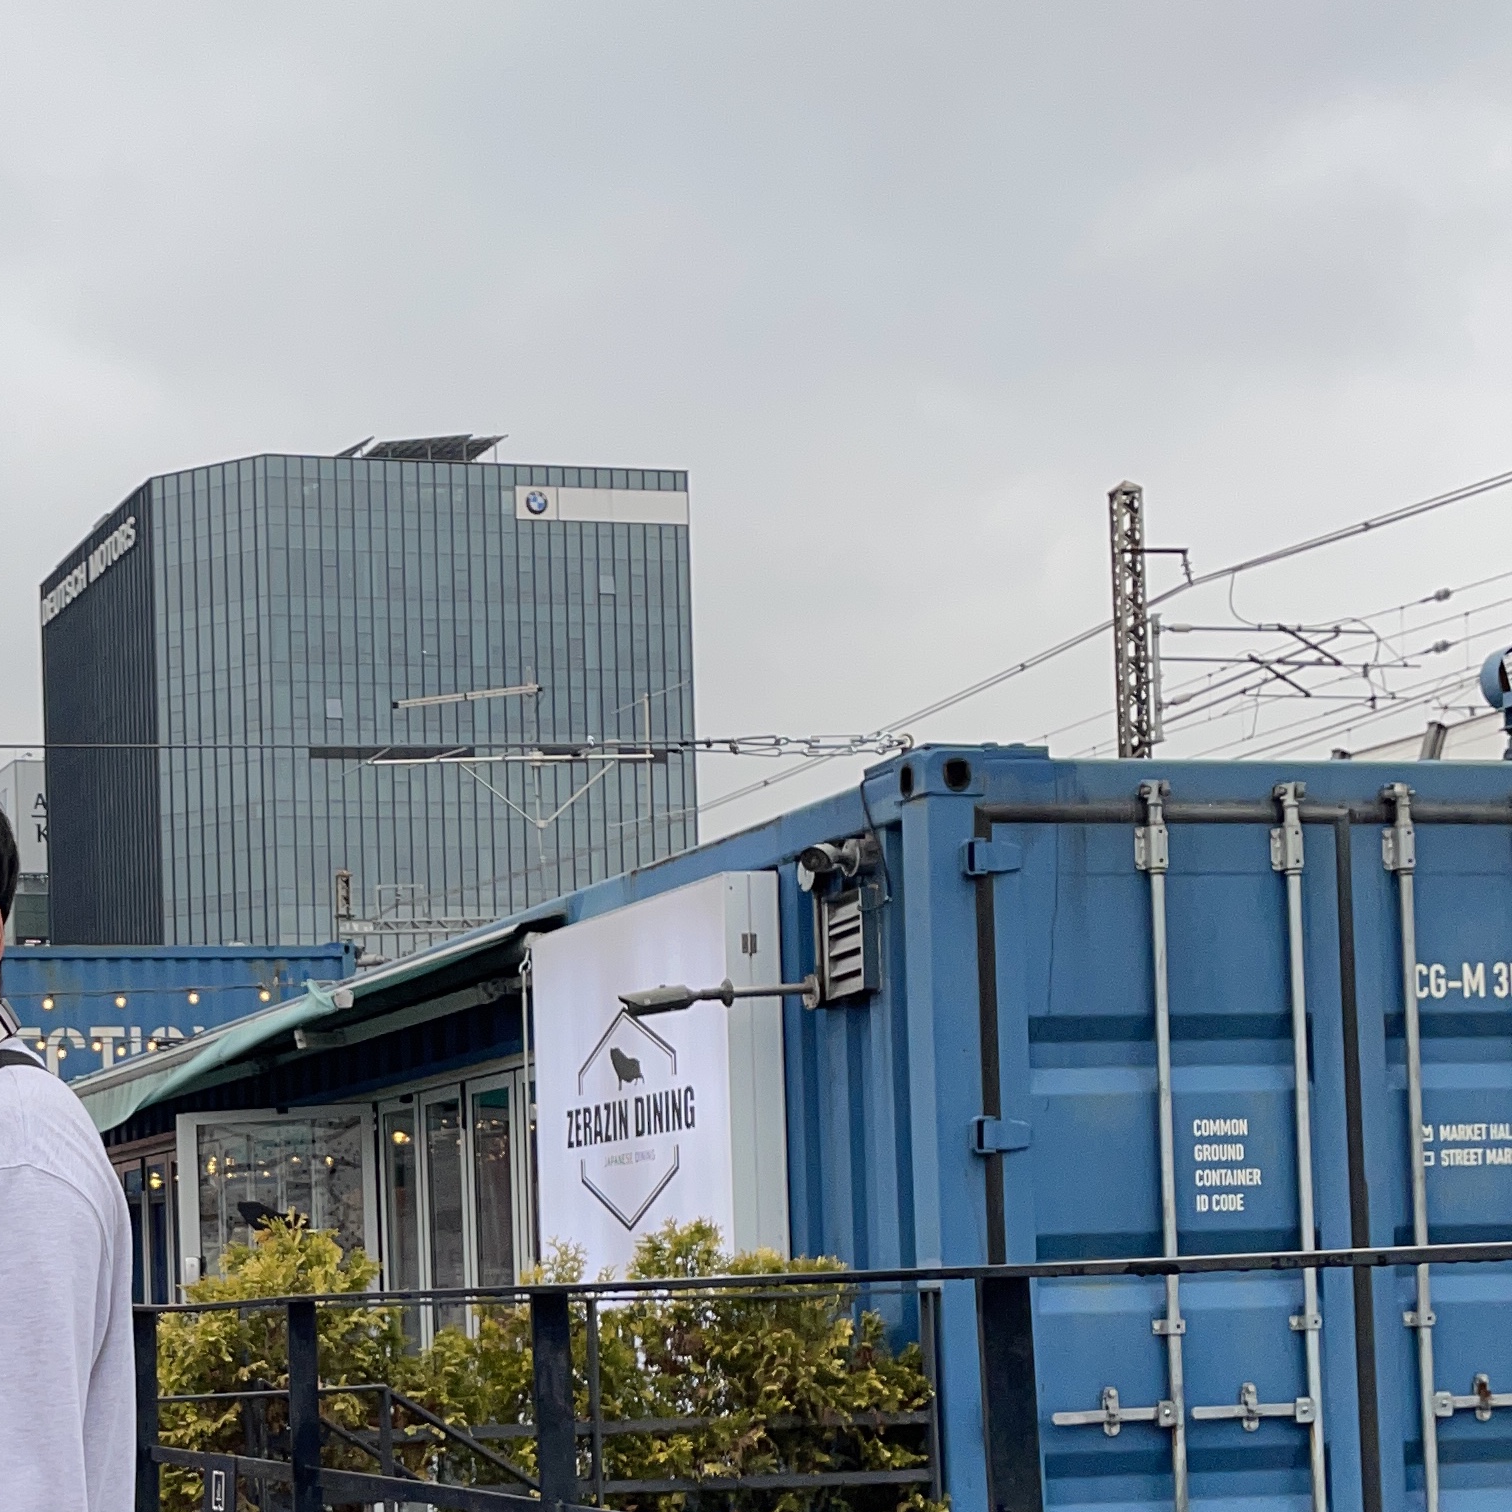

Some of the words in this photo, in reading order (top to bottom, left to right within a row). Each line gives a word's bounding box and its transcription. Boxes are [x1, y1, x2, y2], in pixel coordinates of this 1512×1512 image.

[88, 522, 136, 583] MOTORS
[1493, 962, 1512, 998] 3
[567, 1099, 629, 1149] ZERAZIN
[635, 1085, 695, 1137] DINING
[1193, 1118, 1248, 1137] COMMON
[1439, 1123, 1487, 1142] MARKET
[604, 1152, 633, 1167] JAPANESE
[1194, 1143, 1244, 1162] GROUND
[1441, 1149, 1484, 1167] STREET
[1195, 1168, 1262, 1187] CONTAINER
[1196, 1194, 1209, 1212] ID
[1212, 1193, 1245, 1212] CODE
